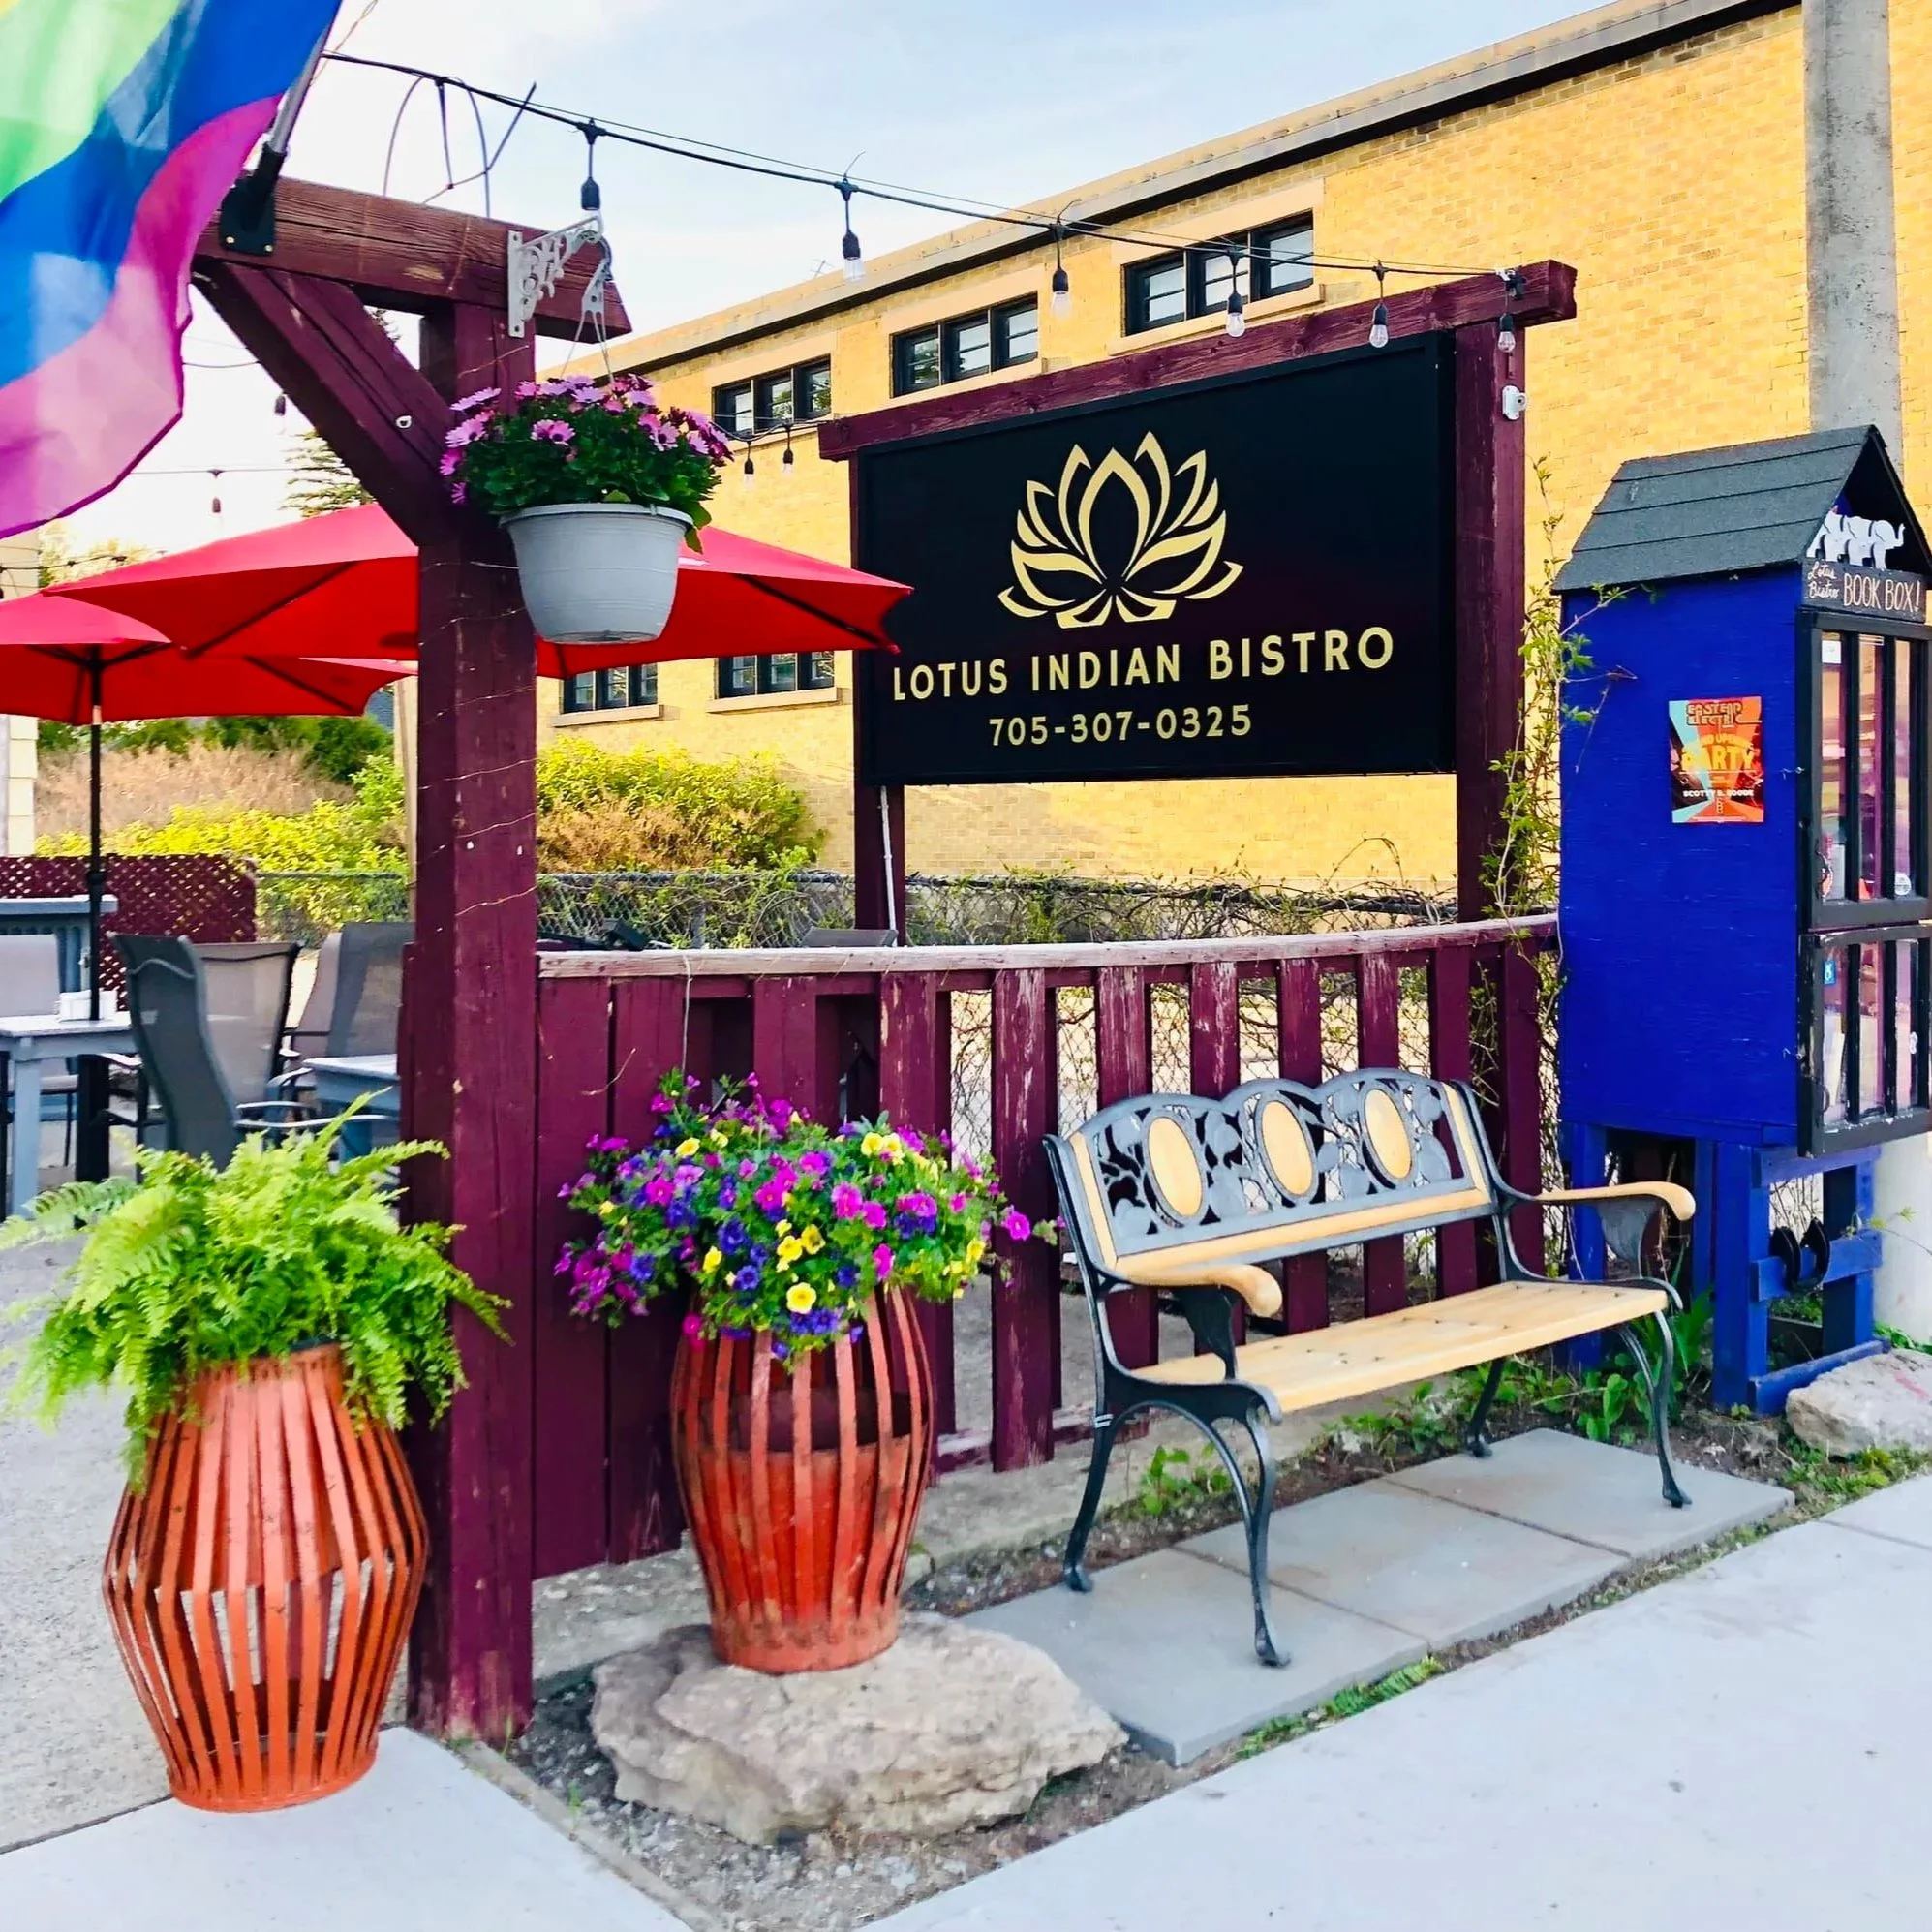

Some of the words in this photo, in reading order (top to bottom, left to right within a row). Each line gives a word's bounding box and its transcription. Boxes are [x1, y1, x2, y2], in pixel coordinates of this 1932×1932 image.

[1843, 573, 1880, 609] BOOK
[1885, 579, 1921, 613] BOX!
[893, 659, 1008, 700] LOTUS
[1031, 643, 1181, 691] INDIAN
[1210, 626, 1395, 680] BISTRO
[989, 704, 1252, 746] 705-307-0325
[1681, 745, 1755, 771] PARTY
